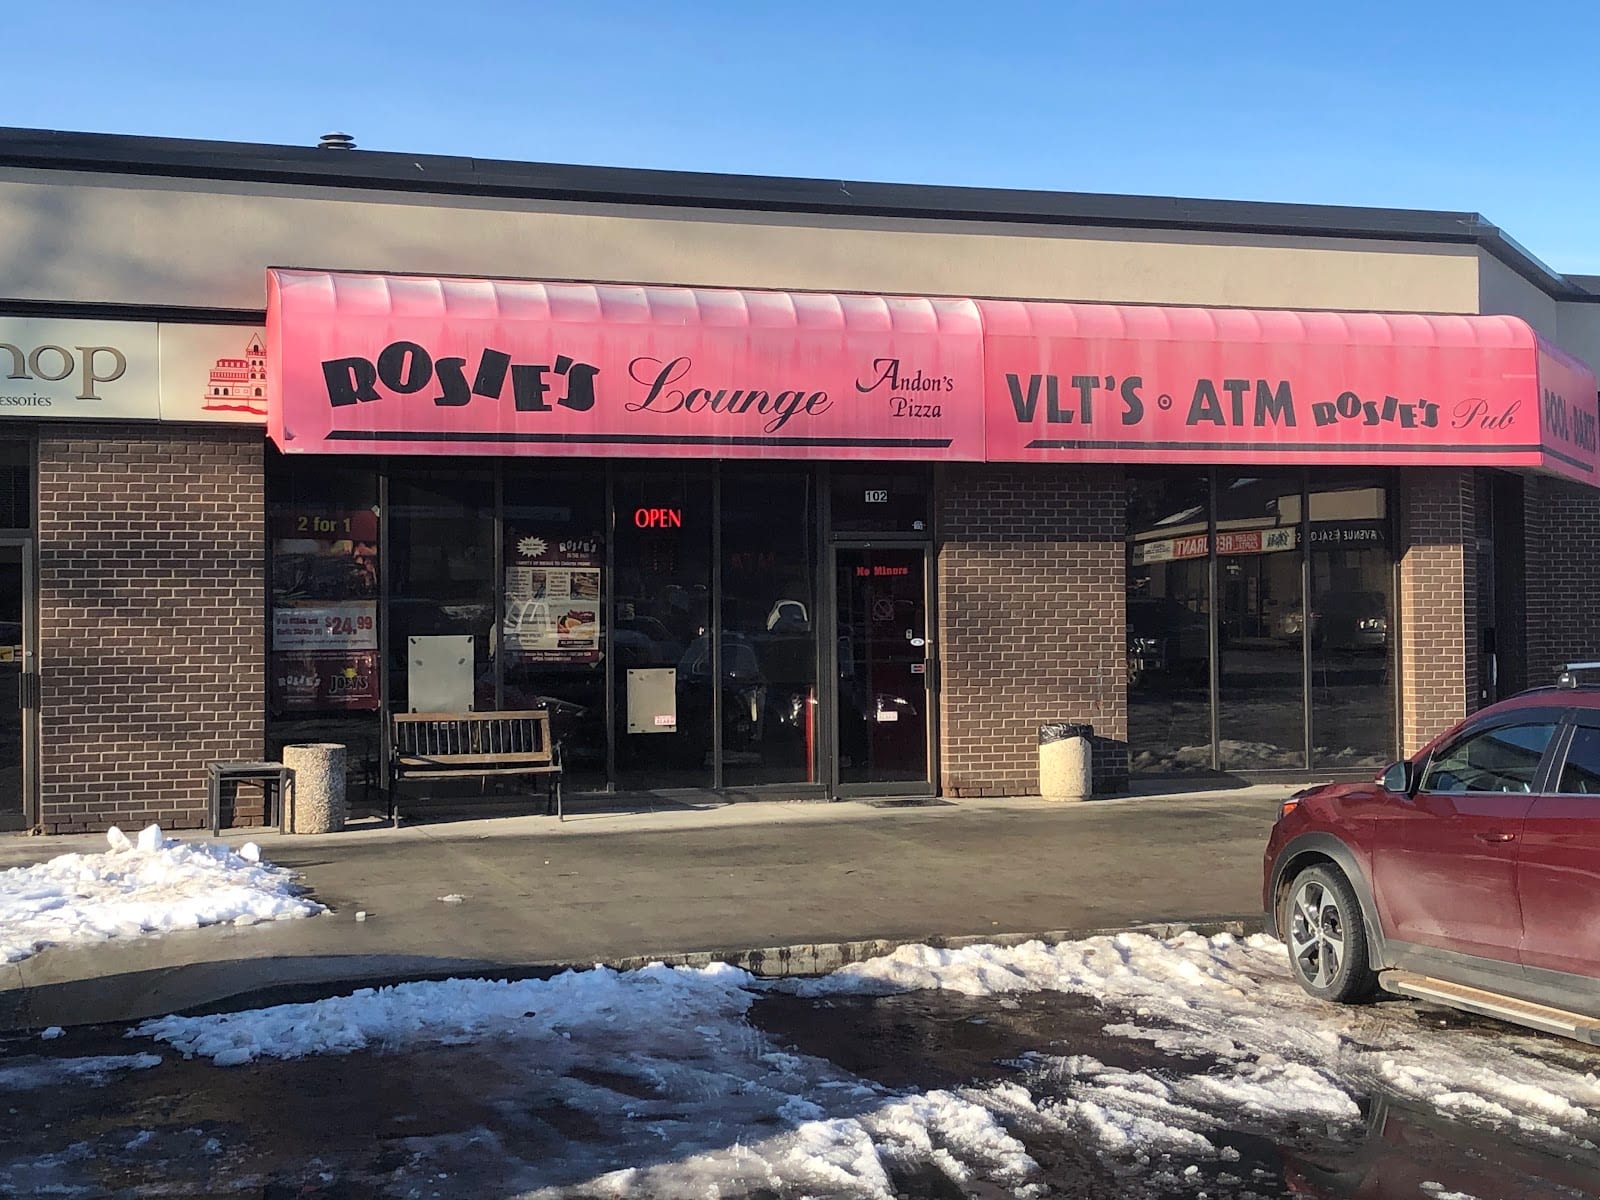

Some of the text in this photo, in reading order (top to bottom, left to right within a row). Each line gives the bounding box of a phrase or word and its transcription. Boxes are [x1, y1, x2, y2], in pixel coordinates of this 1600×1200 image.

[855, 357, 954, 393] Andon's
[321, 340, 834, 434] ROSIE'S Lounge
[889, 396, 942, 418] Pizza
[1005, 373, 1297, 427] VLT'S ATM
[1312, 391, 1522, 430] ROSIE'S Pub
[1544, 388, 1569, 441] POOL
[865, 490, 888, 502] 102
[297, 516, 351, 532] 2 for 1
[635, 508, 681, 528] OPEN
[856, 565, 909, 576] No Minors
[325, 616, 373, 635] $24.99
